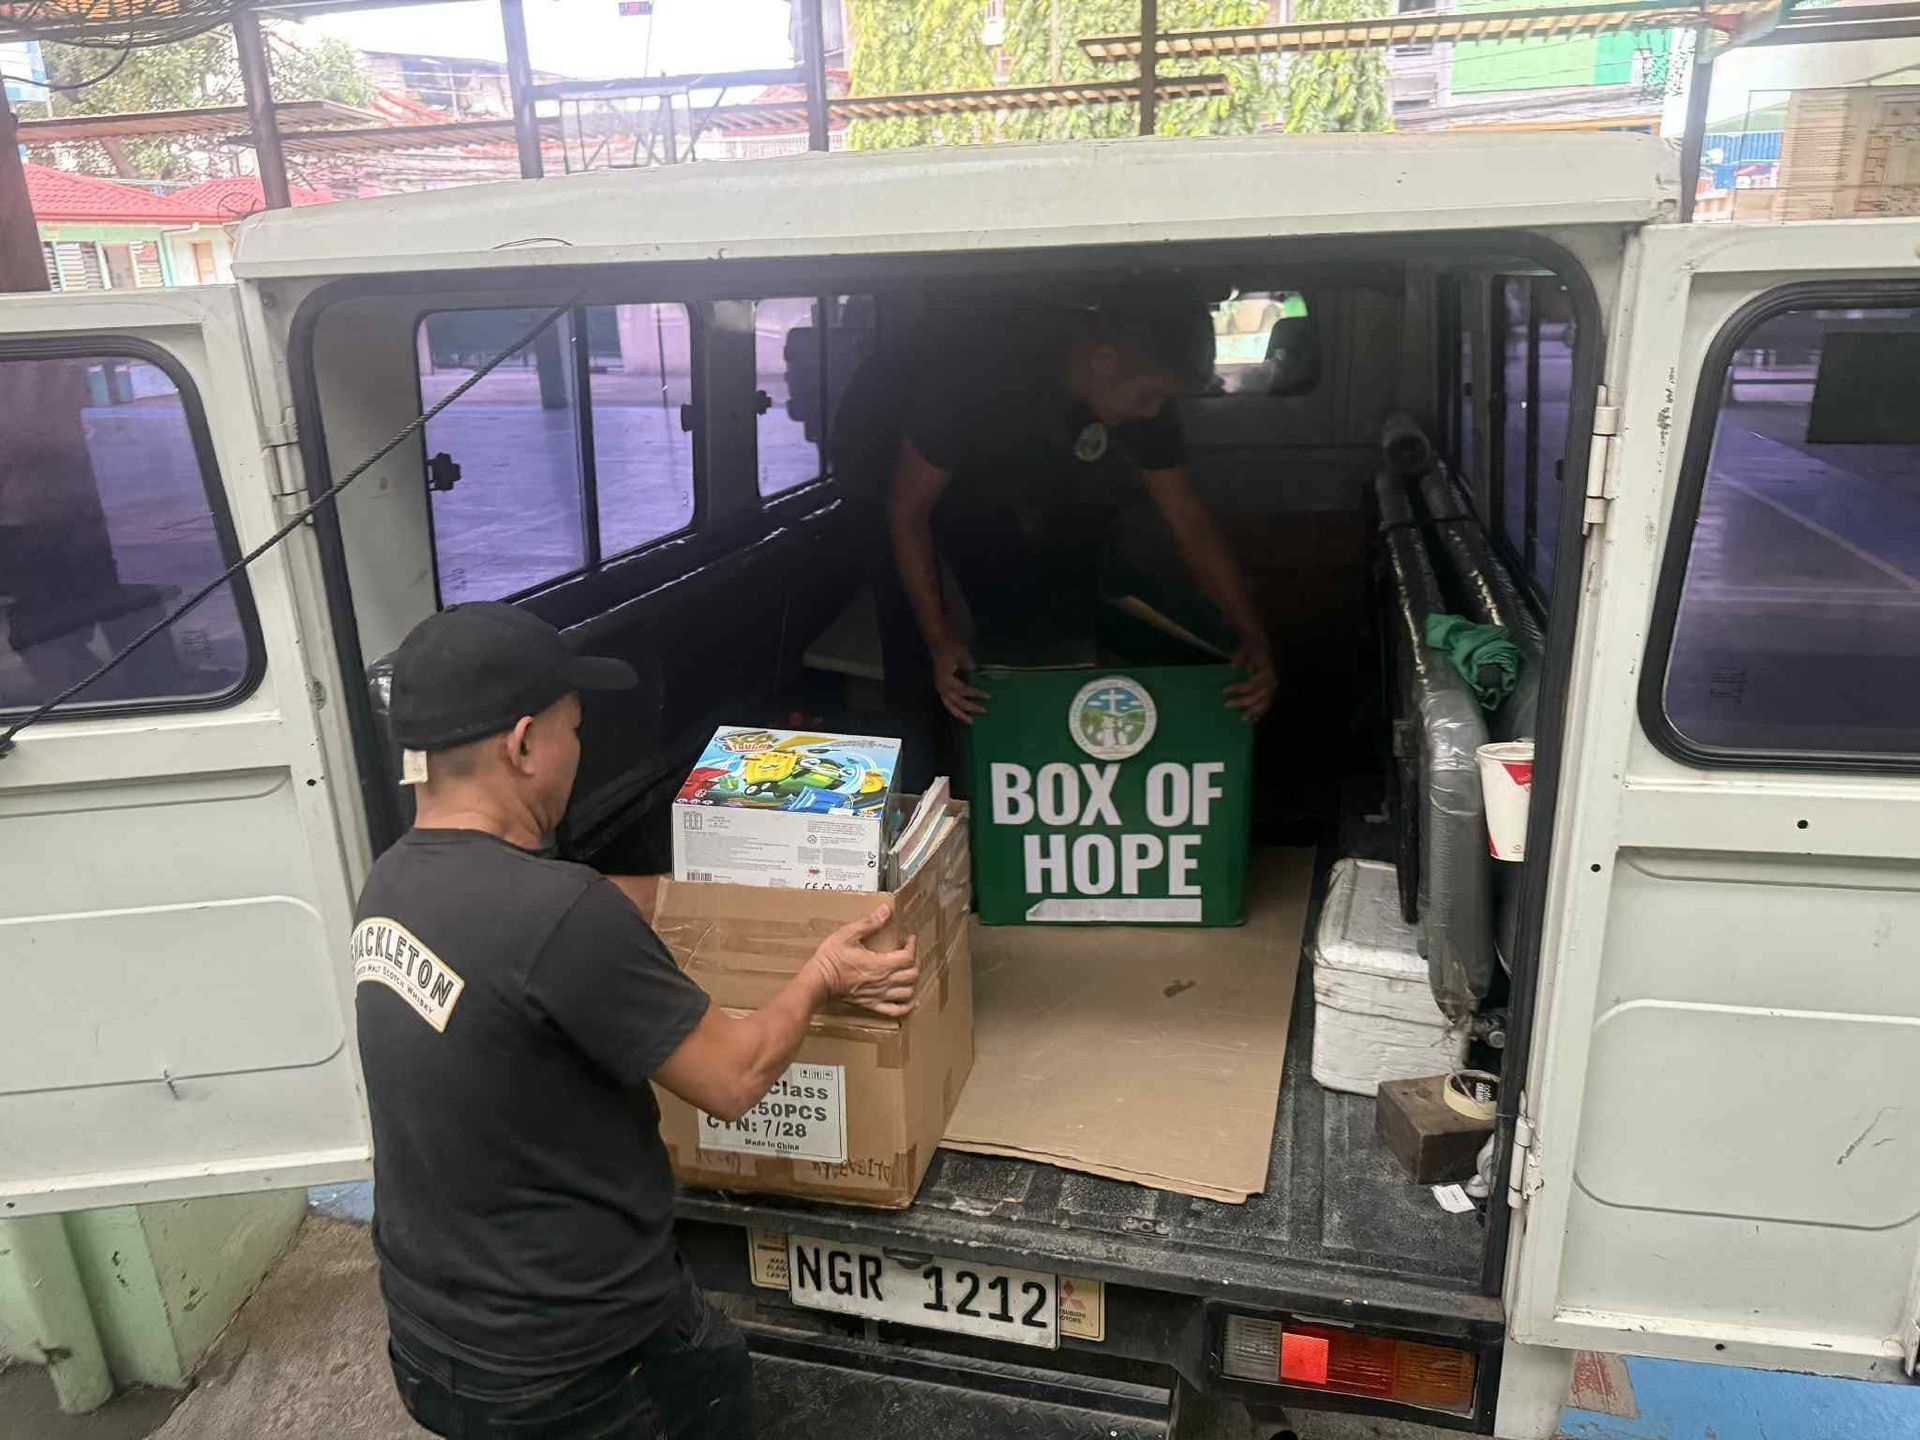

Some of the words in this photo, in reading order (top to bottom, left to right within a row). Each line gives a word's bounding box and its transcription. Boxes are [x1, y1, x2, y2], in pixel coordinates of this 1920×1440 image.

[990, 762, 1122, 826] BOX
[1145, 762, 1224, 827] OF
[1023, 833, 1202, 896] HOPE
[763, 1118, 808, 1138] 7/28
[776, 1141, 800, 1151] China
[796, 1245, 883, 1302] NGR
[922, 1265, 1048, 1329] 1212
